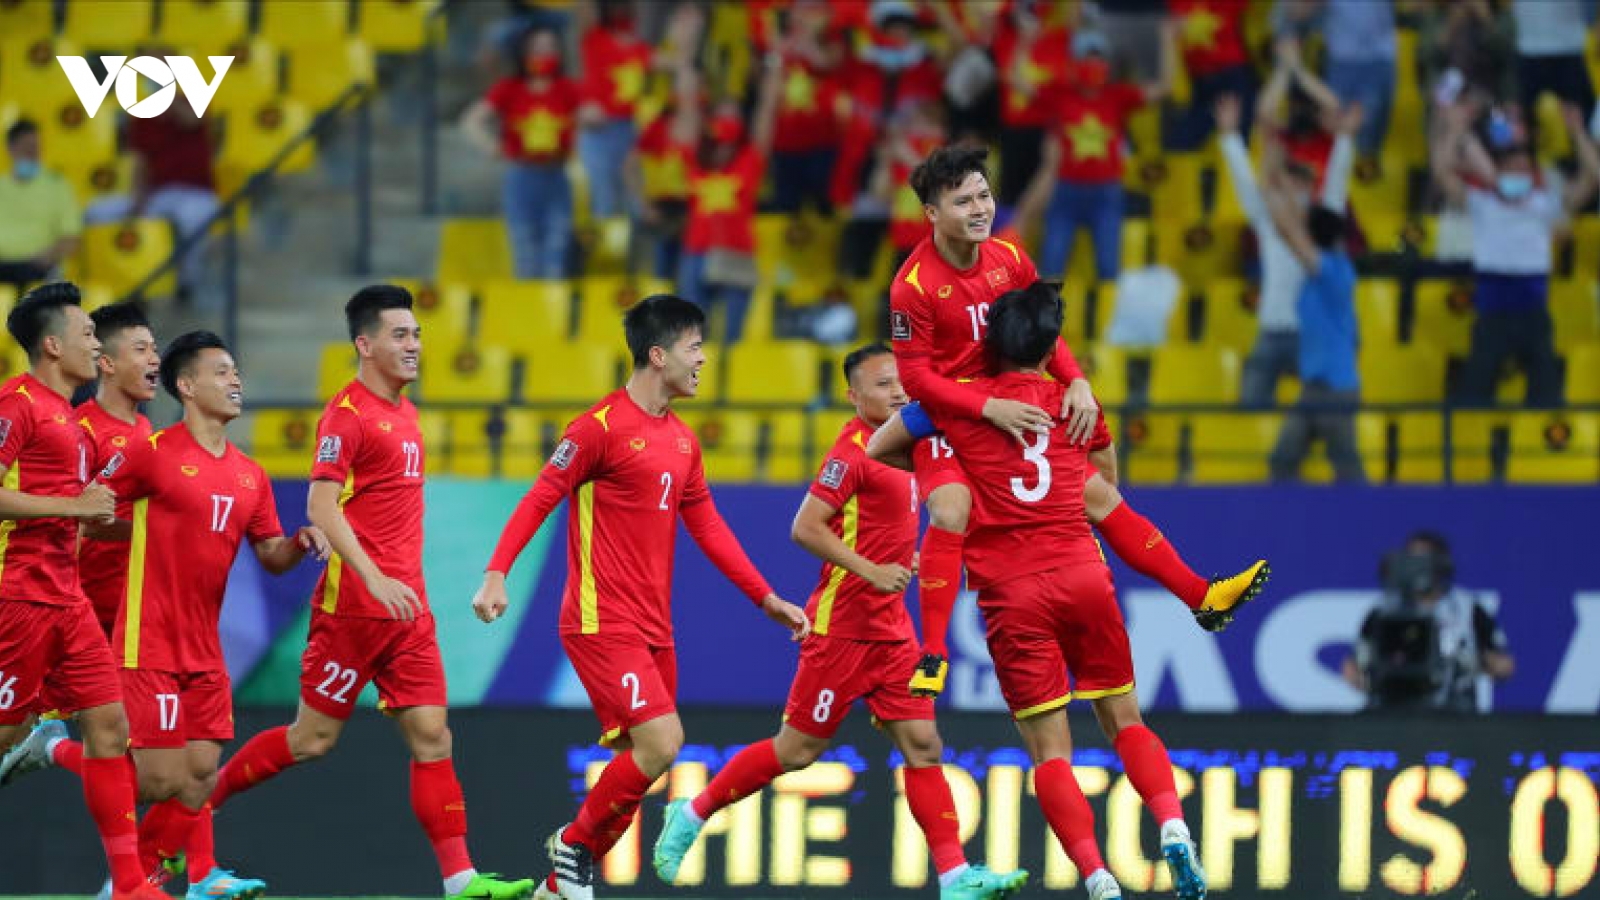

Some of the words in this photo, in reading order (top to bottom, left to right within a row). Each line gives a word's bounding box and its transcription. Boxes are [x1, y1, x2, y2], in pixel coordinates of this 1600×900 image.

[402, 440, 421, 477] 22
[1010, 423, 1052, 503] 3
[659, 471, 672, 511] 2
[211, 494, 235, 532] 17
[0, 670, 18, 710] 6
[314, 660, 359, 705] 22
[621, 672, 647, 710] 2
[155, 693, 180, 731] 17
[812, 688, 836, 724] 8
[584, 760, 855, 887] THE
[890, 762, 1293, 893] PITCH
[1338, 765, 1468, 896] IS
